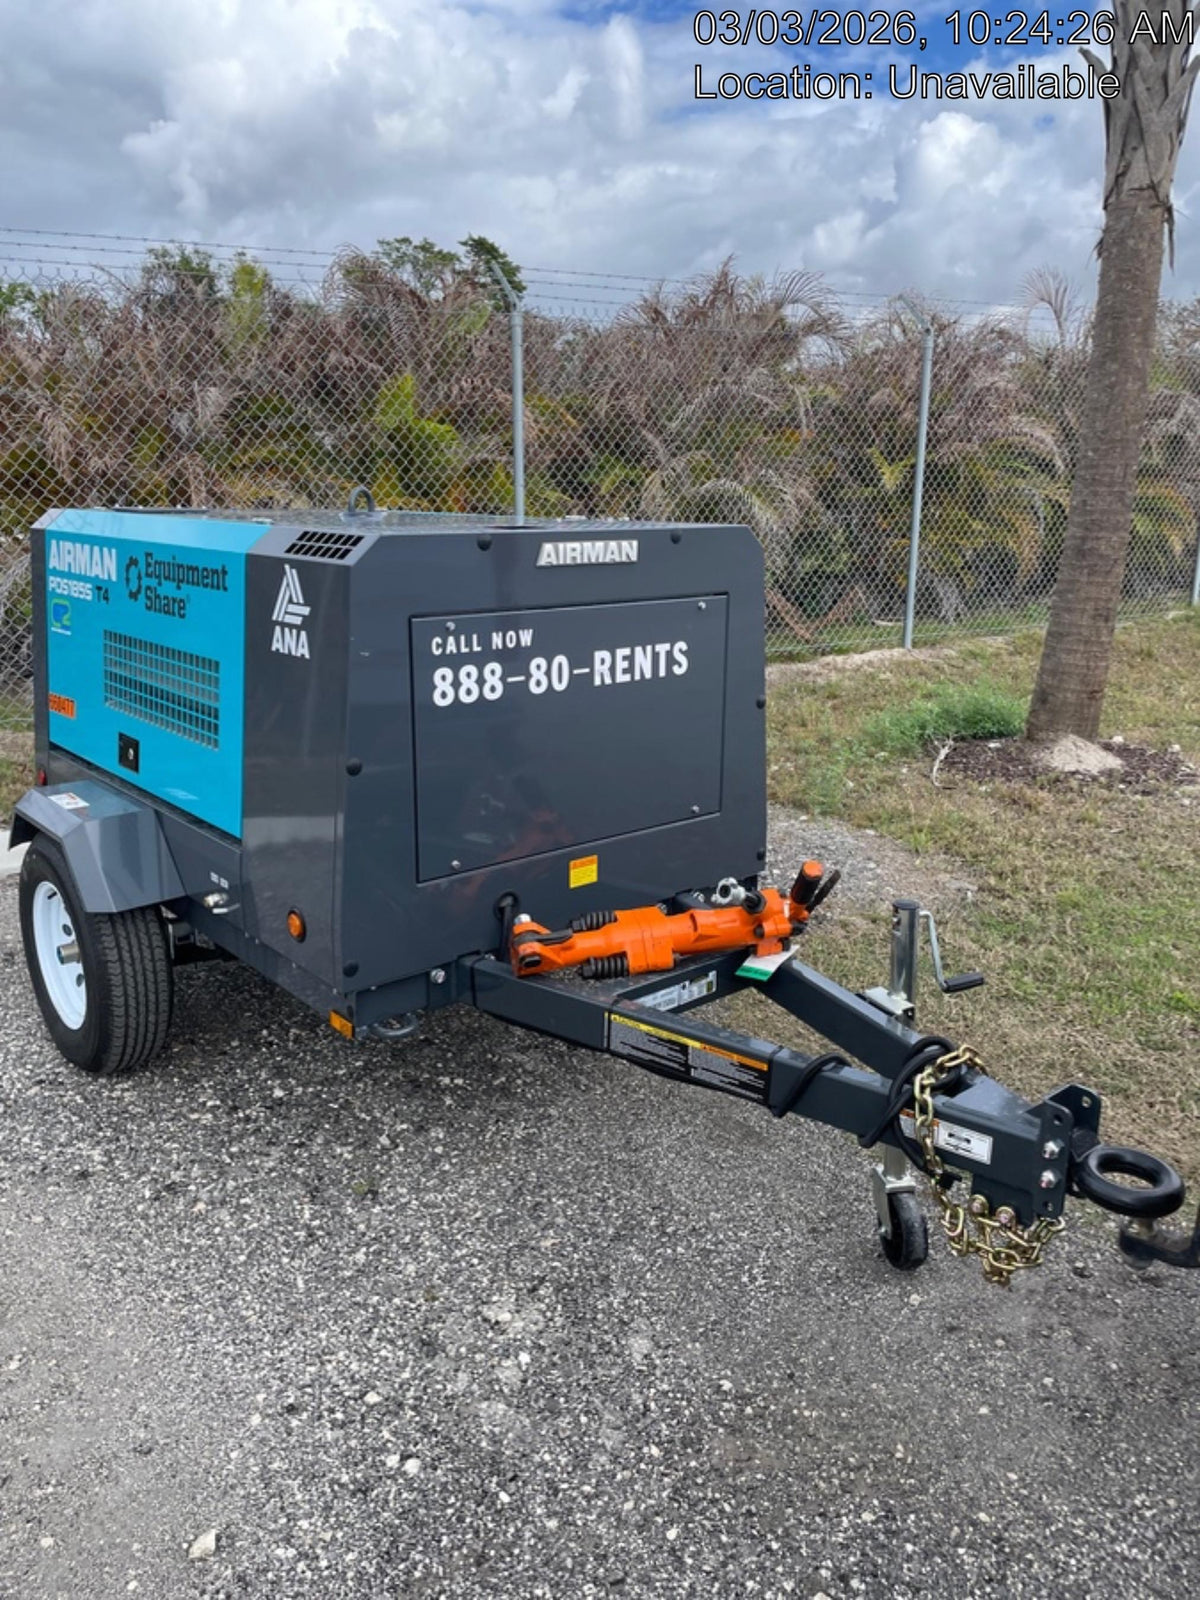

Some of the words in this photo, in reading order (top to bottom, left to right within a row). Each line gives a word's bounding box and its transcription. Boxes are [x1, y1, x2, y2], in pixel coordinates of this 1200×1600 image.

[49, 539, 117, 581] AIRMAN
[536, 540, 638, 567] AIRMAN
[144, 551, 228, 592] Equipment
[96, 585, 110, 604] T4
[271, 625, 310, 659] ANA
[431, 633, 482, 655] CALL
[491, 629, 533, 650] NOW
[432, 641, 689, 707] 888-80-RENTS
